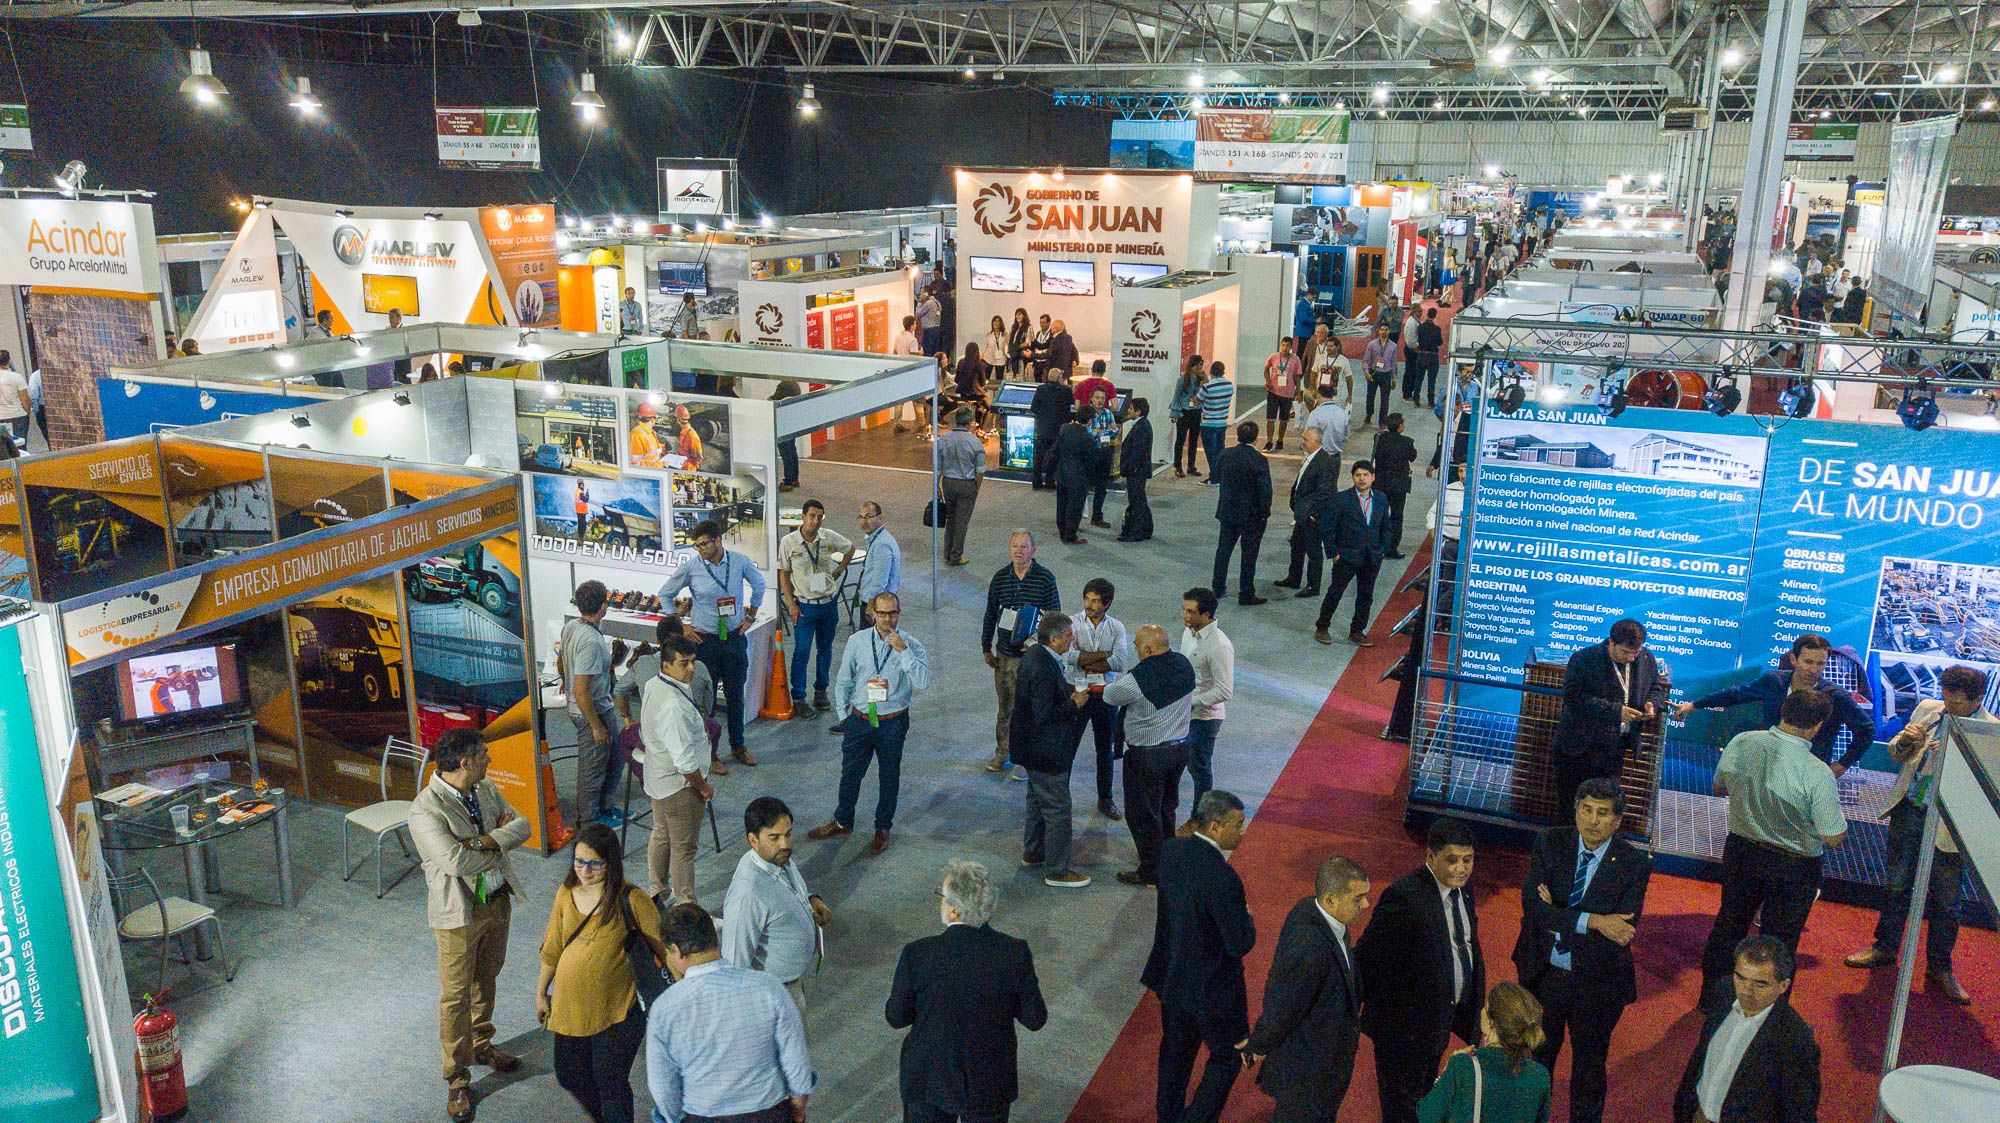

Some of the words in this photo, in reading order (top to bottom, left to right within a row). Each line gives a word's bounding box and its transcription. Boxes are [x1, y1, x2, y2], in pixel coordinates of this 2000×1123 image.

[1272, 151, 1302, 159] STANDS
[1026, 189, 1082, 200] GOBIERNO
[1085, 190, 1100, 200] DE
[514, 213, 546, 224] MARLEW
[1026, 204, 1084, 231] SAN
[1088, 206, 1163, 233] JUAN
[27, 218, 127, 258] Acindar
[516, 236, 534, 246] para
[372, 240, 456, 258] MARLEW
[1028, 242, 1095, 254] MINISTERIO
[1096, 244, 1112, 253] DE
[1116, 242, 1165, 256] MINERÍA
[30, 256, 66, 274] Grupo
[68, 258, 128, 275] ArcelorMittal
[232, 275, 264, 285] MARLEW
[1122, 348, 1141, 358] SAN
[1143, 350, 1168, 360] JUAN
[1537, 410, 1566, 422] SAN
[1568, 412, 1607, 425] JUAN
[88, 456, 136, 480] SERVICIO
[138, 453, 152, 470] DE
[1800, 456, 1846, 485] DE
[1852, 462, 1932, 492] SAN
[119, 467, 153, 483] CIVILES
[1480, 468, 1507, 482] Único
[1509, 472, 1561, 486] fabricante
[1563, 477, 1576, 488] de
[1578, 478, 1613, 492] rejillas
[1615, 481, 1697, 499] electroforjadas
[1700, 488, 1717, 499] del
[1718, 490, 1745, 503] país.
[1477, 485, 1528, 498] Proveedor
[1530, 488, 1596, 506] homologado
[1598, 496, 1616, 507] por
[1477, 497, 1503, 508] Mesa
[1505, 499, 1518, 510] de
[1521, 501, 1596, 517] Homologación
[1599, 507, 1637, 520] Minera.
[1792, 489, 1834, 517] AL
[1845, 493, 1983, 530] MUNDO
[1475, 513, 1534, 527] Distribución
[1545, 518, 1568, 531] nivel
[1571, 522, 1616, 535] nacional
[1618, 525, 1631, 536] de
[1634, 526, 1654, 539] Red
[1657, 529, 1701, 543] Acindar.
[532, 534, 577, 554] TODO
[582, 540, 606, 557] EN
[611, 547, 638, 563] UN
[1784, 548, 1825, 560] OBRAS
[1827, 552, 1844, 562] EN
[214, 566, 280, 606] EMPRESA
[282, 541, 368, 586] COMUNITARIA
[370, 536, 386, 558] DE
[389, 520, 432, 552] JACHAL
[437, 507, 482, 535] SERVICIOS
[1472, 538, 1748, 577] www.rejillasmetalicas.com.ar
[1783, 558, 1845, 574] SECTORES
[1468, 579, 1527, 594] ARGENTINA
[1470, 564, 1482, 575] EL
[1484, 565, 1511, 578] PISO
[1514, 568, 1529, 579] DE
[1531, 568, 1554, 581] LOS
[1556, 571, 1611, 588] GRANDES
[1613, 577, 1686, 596] PROYECTOS
[1687, 586, 1745, 602] MINEROS
[1780, 579, 1818, 591] -Minero
[1468, 592, 1493, 600] Minera
[1494, 594, 1535, 605] Alumbrera
[1778, 592, 1826, 605] -Petrolero
[1467, 601, 1500, 611] Proyecto
[1501, 604, 1535, 616] Veladero
[1553, 600, 1594, 612] -Manantial
[1596, 604, 1624, 616] Espejo
[1776, 606, 1826, 619] -Cerealero
[1466, 610, 1486, 620] Cerro
[1487, 613, 1531, 626] Vanguardia
[1552, 611, 1603, 623] -Gualcamayo
[1645, 611, 1696, 623] -Yacimientos
[1698, 616, 1711, 625] Río
[1713, 618, 1738, 628] Turbio
[1465, 621, 1498, 632] Proyecto
[1499, 624, 1514, 633] San
[1515, 626, 1535, 636] José
[1550, 621, 1588, 632] -Casposo
[1644, 621, 1677, 632] -Pascua
[1678, 625, 1702, 634] Lama
[1774, 619, 1831, 633] -Cementero
[1464, 632, 1482, 640] Mina
[1484, 634, 1517, 645] Pirquitas
[1549, 632, 1574, 641] -Sierra
[1678, 636, 1692, 644] Río
[1694, 638, 1732, 649] Colorado
[1548, 642, 1570, 651] -Mina
[1668, 645, 1693, 655] Negro
[1462, 649, 1500, 662] BOLIVIA
[1462, 661, 1485, 671] Minera
[1486, 663, 1501, 672] San
[6, 858, 30, 939] ELECTRICOS
[21, 940, 46, 1022] MATERIALES
